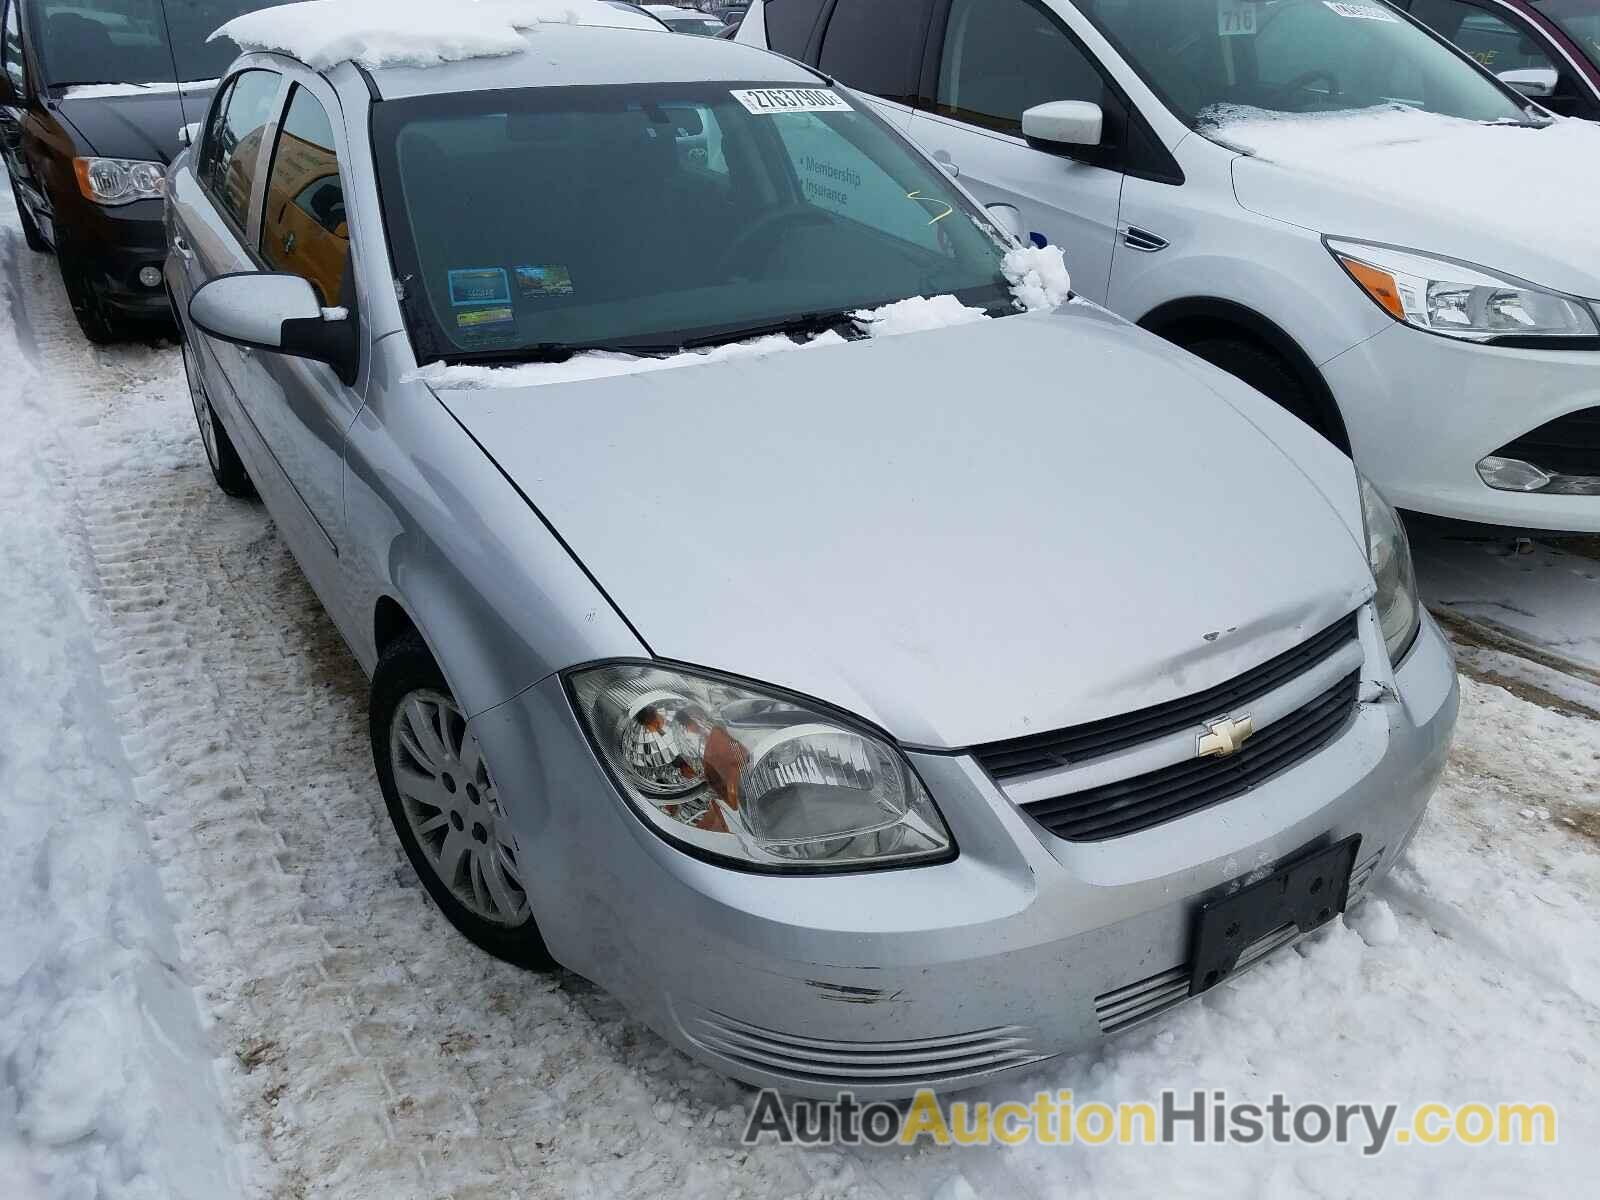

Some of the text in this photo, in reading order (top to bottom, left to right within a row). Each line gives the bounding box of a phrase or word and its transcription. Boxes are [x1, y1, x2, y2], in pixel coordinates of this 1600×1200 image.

[746, 89, 836, 107] 27637900
[806, 155, 862, 192] Membership
[806, 177, 847, 205] Insurance
